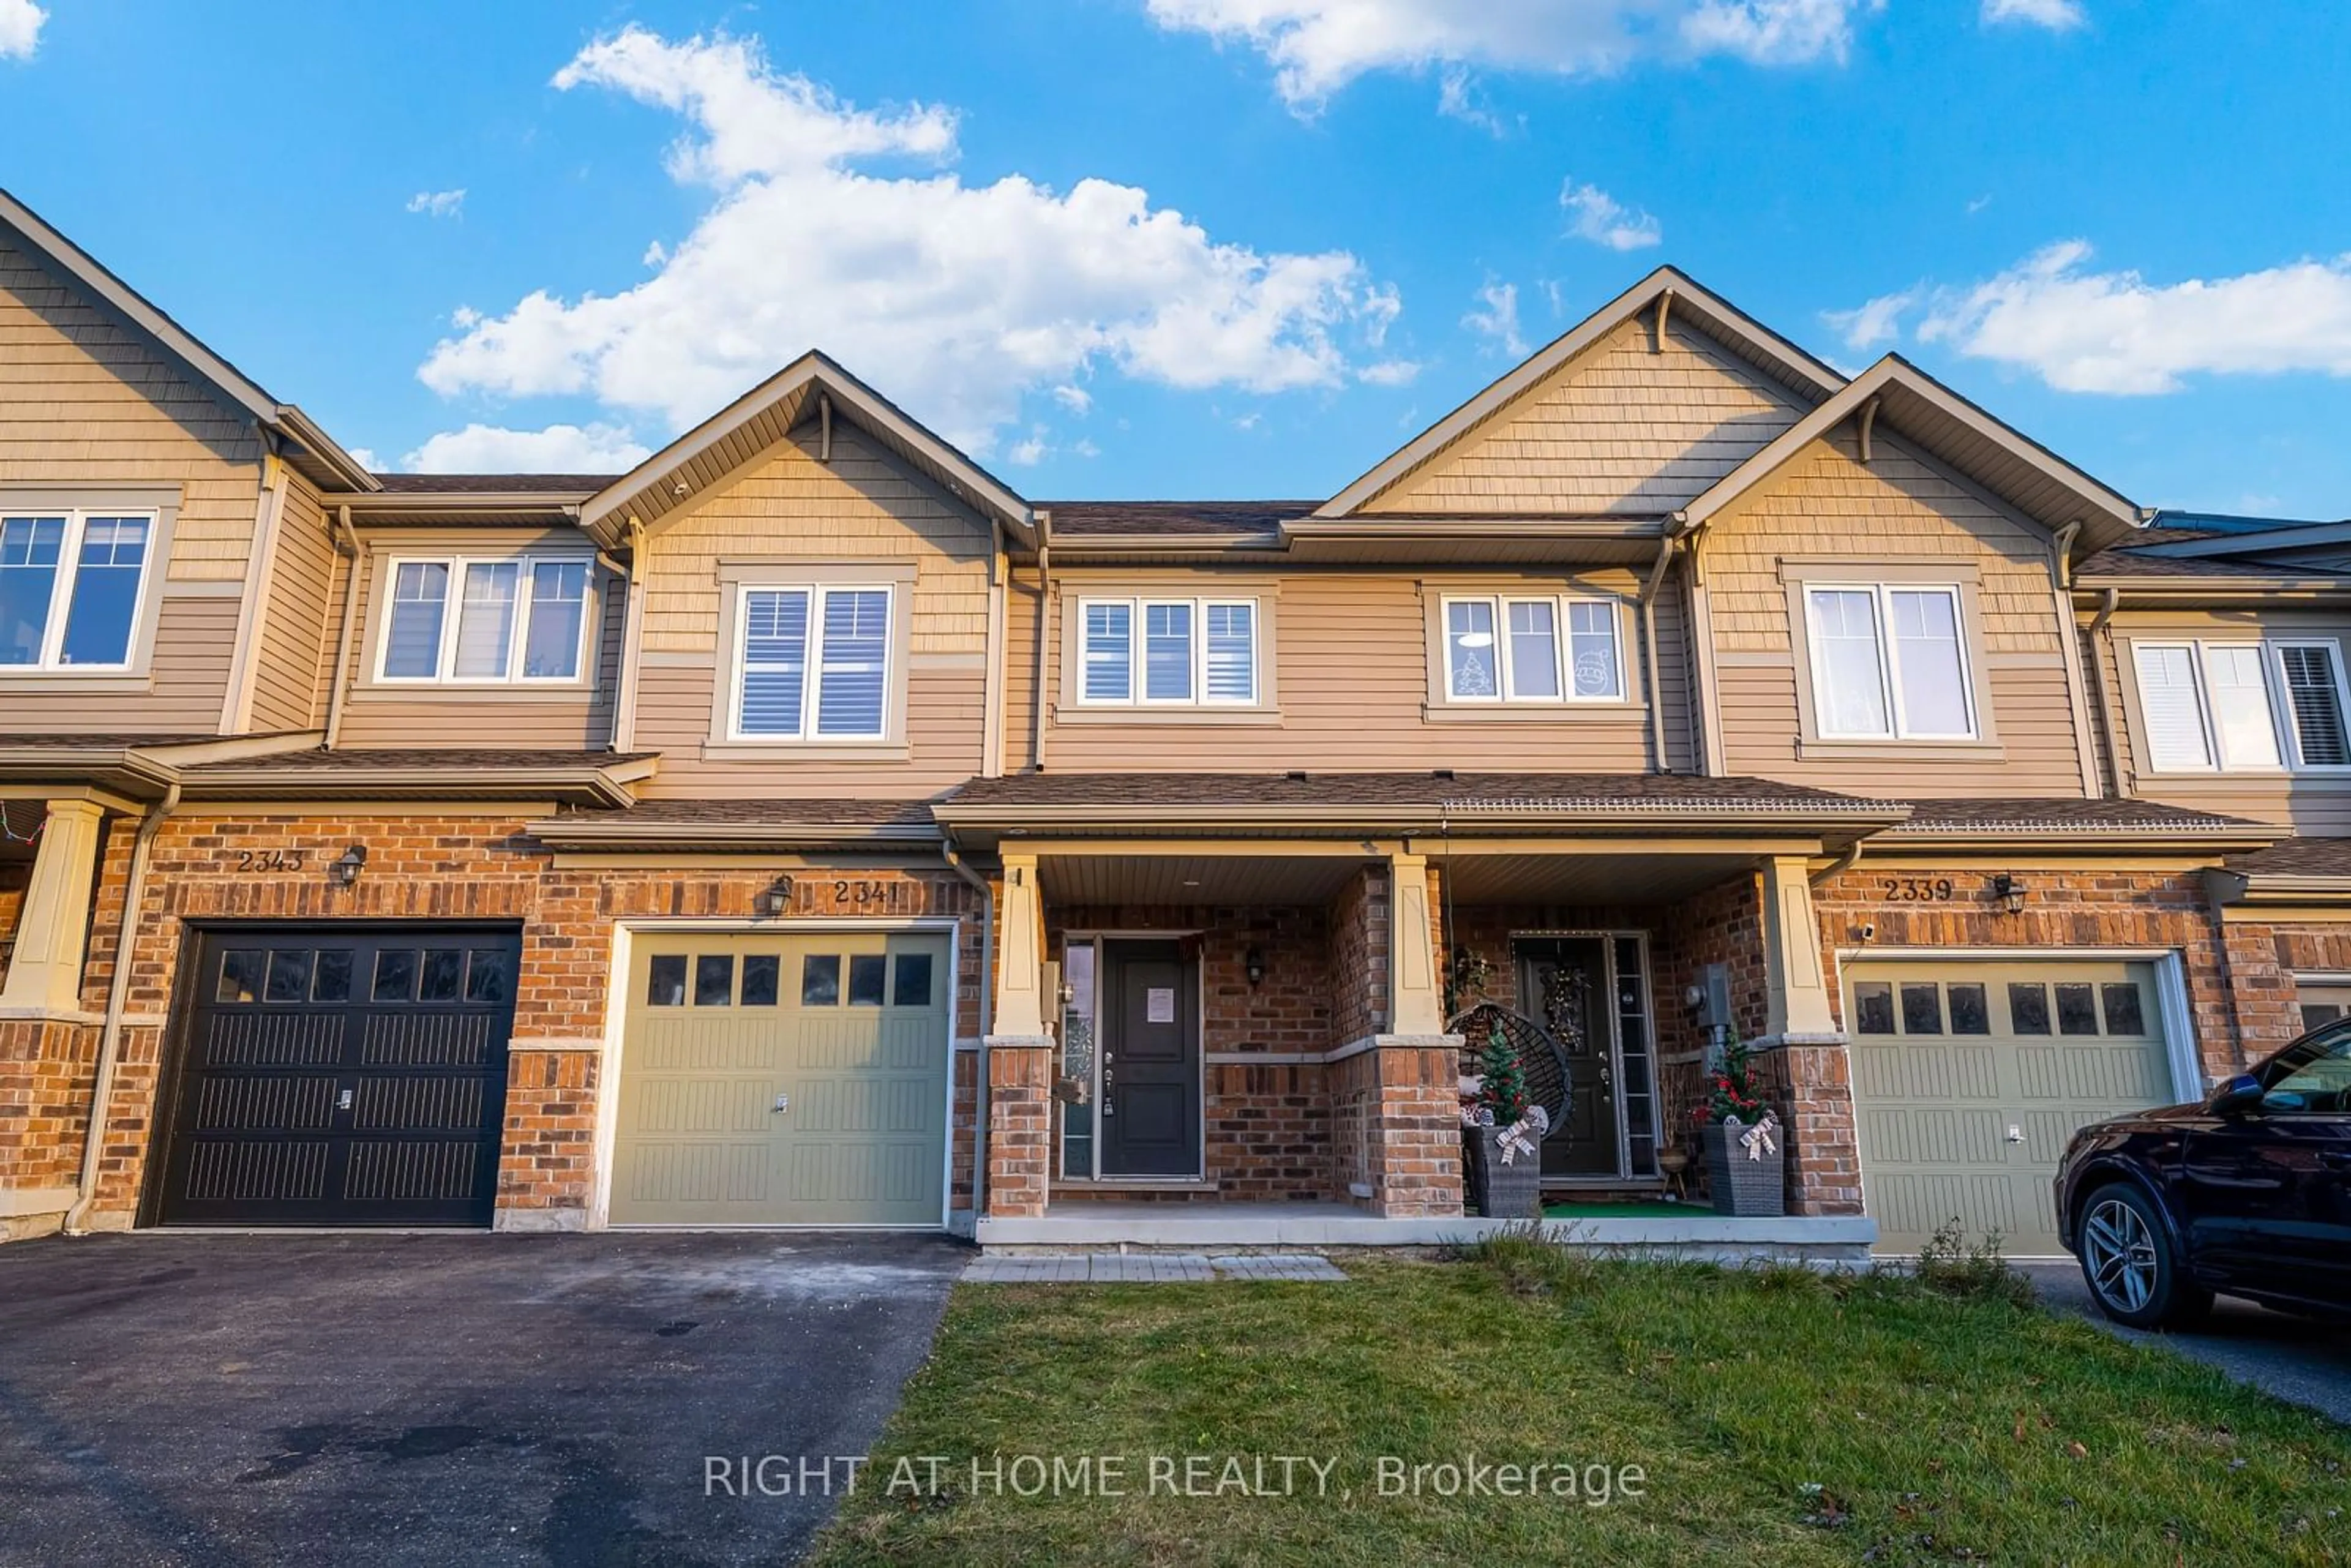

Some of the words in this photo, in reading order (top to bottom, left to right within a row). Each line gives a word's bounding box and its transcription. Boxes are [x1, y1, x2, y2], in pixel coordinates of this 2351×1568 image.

[238, 851, 302, 872] 2343
[835, 881, 898, 902] 2341
[1885, 879, 1951, 901] 2339
